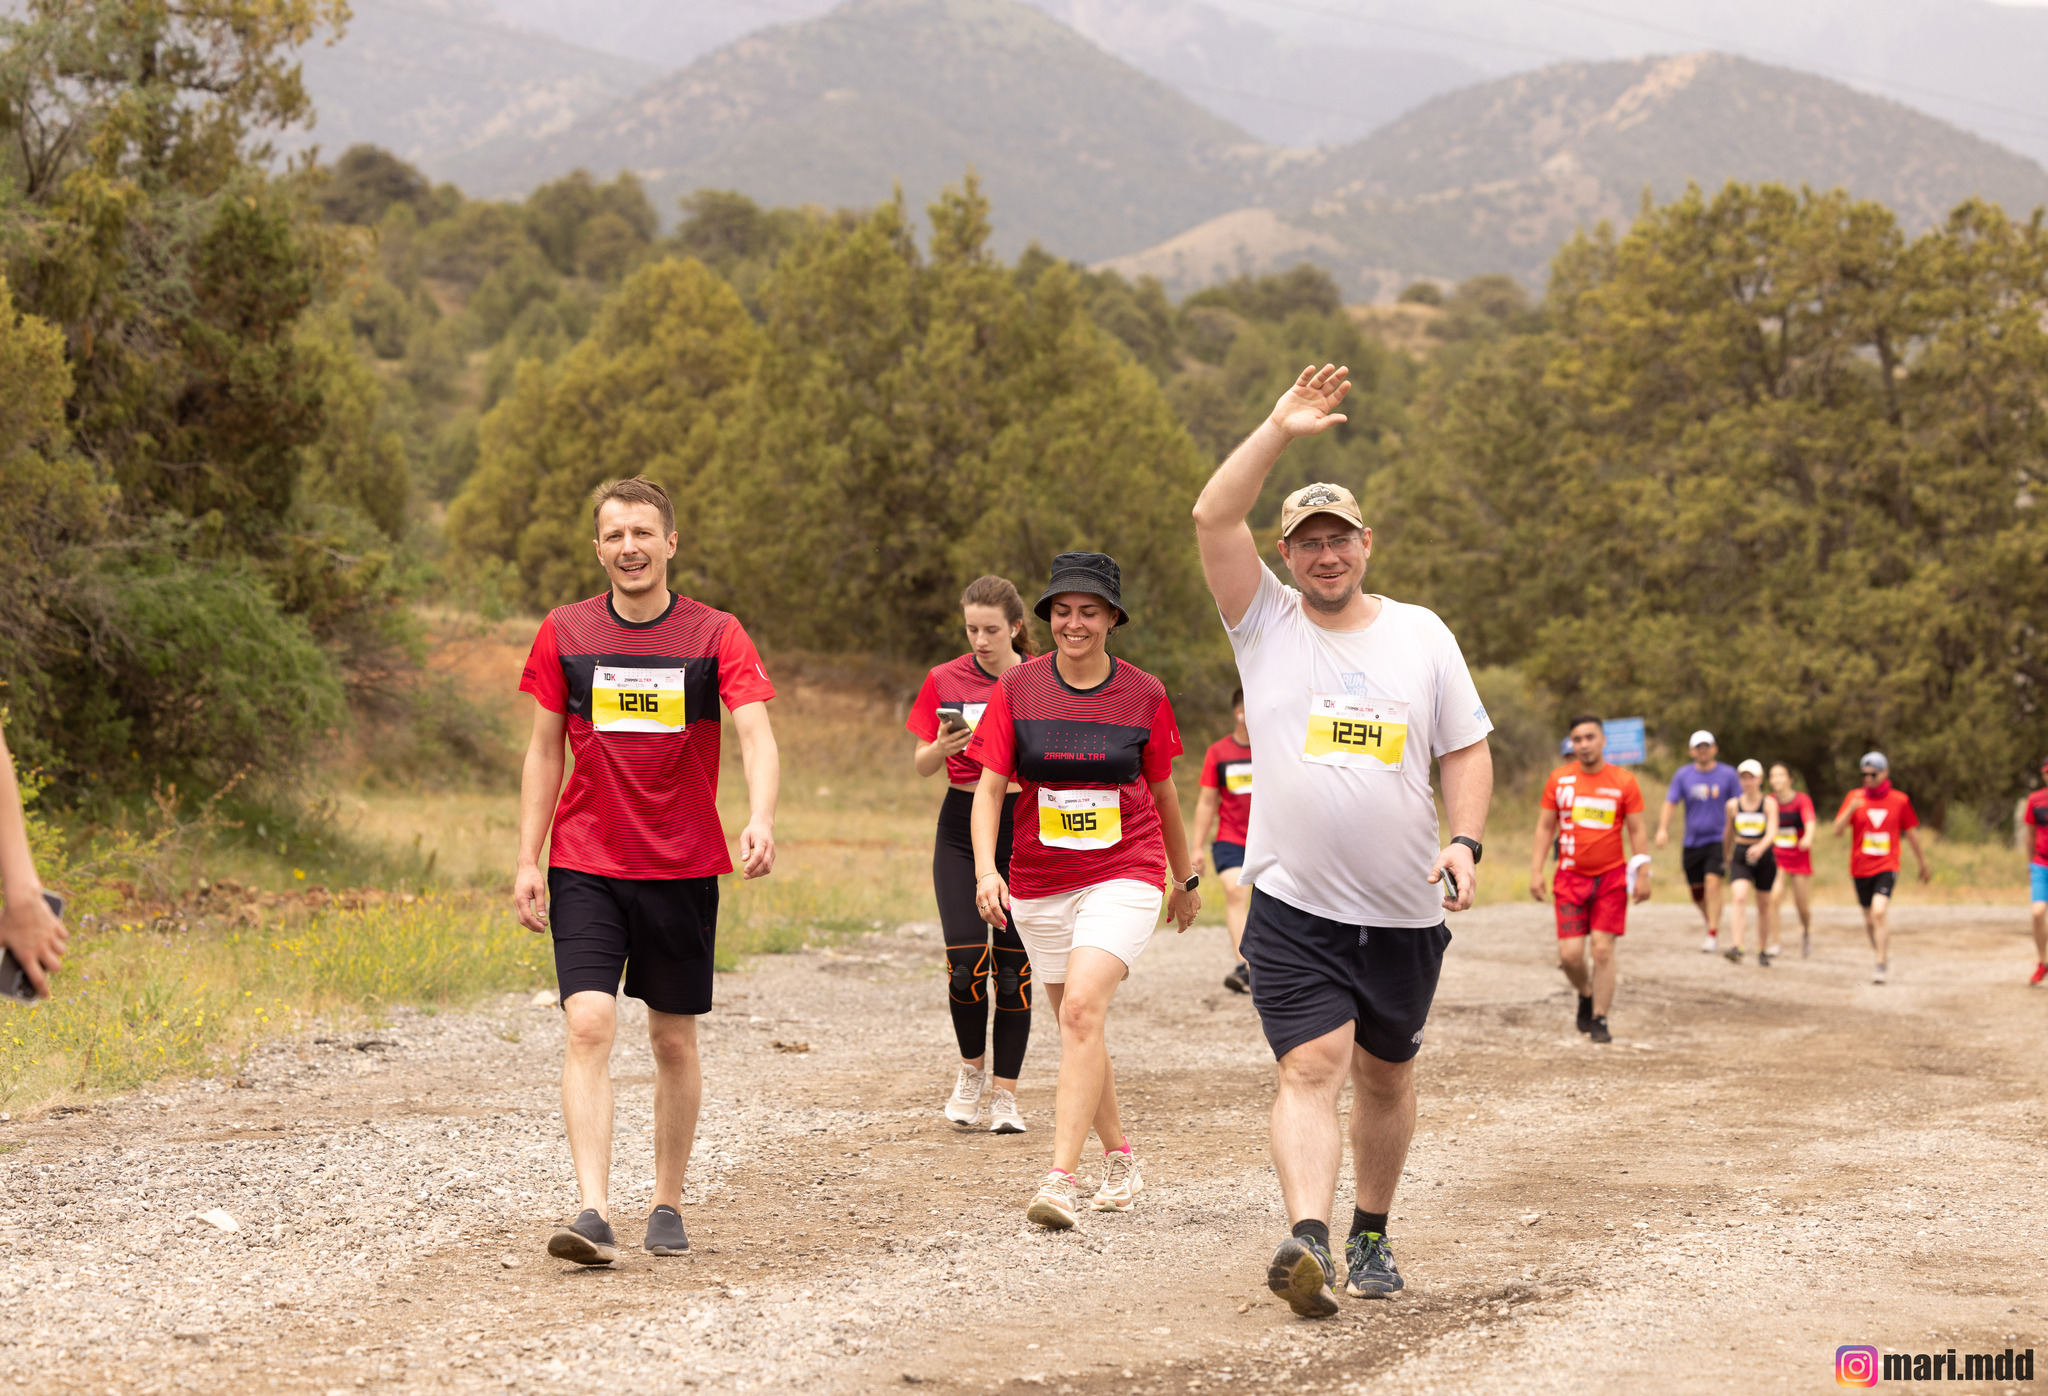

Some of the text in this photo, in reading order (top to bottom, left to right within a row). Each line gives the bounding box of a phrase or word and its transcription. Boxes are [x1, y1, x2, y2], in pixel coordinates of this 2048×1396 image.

[604, 672, 616, 681] 10K
[618, 692, 658, 713] 1216
[1323, 699, 1336, 708] 10K
[1332, 721, 1382, 747] 1234
[1076, 752, 1106, 761] ULTRA
[1047, 793, 1057, 802] 10K
[1060, 811, 1097, 832] 1195
